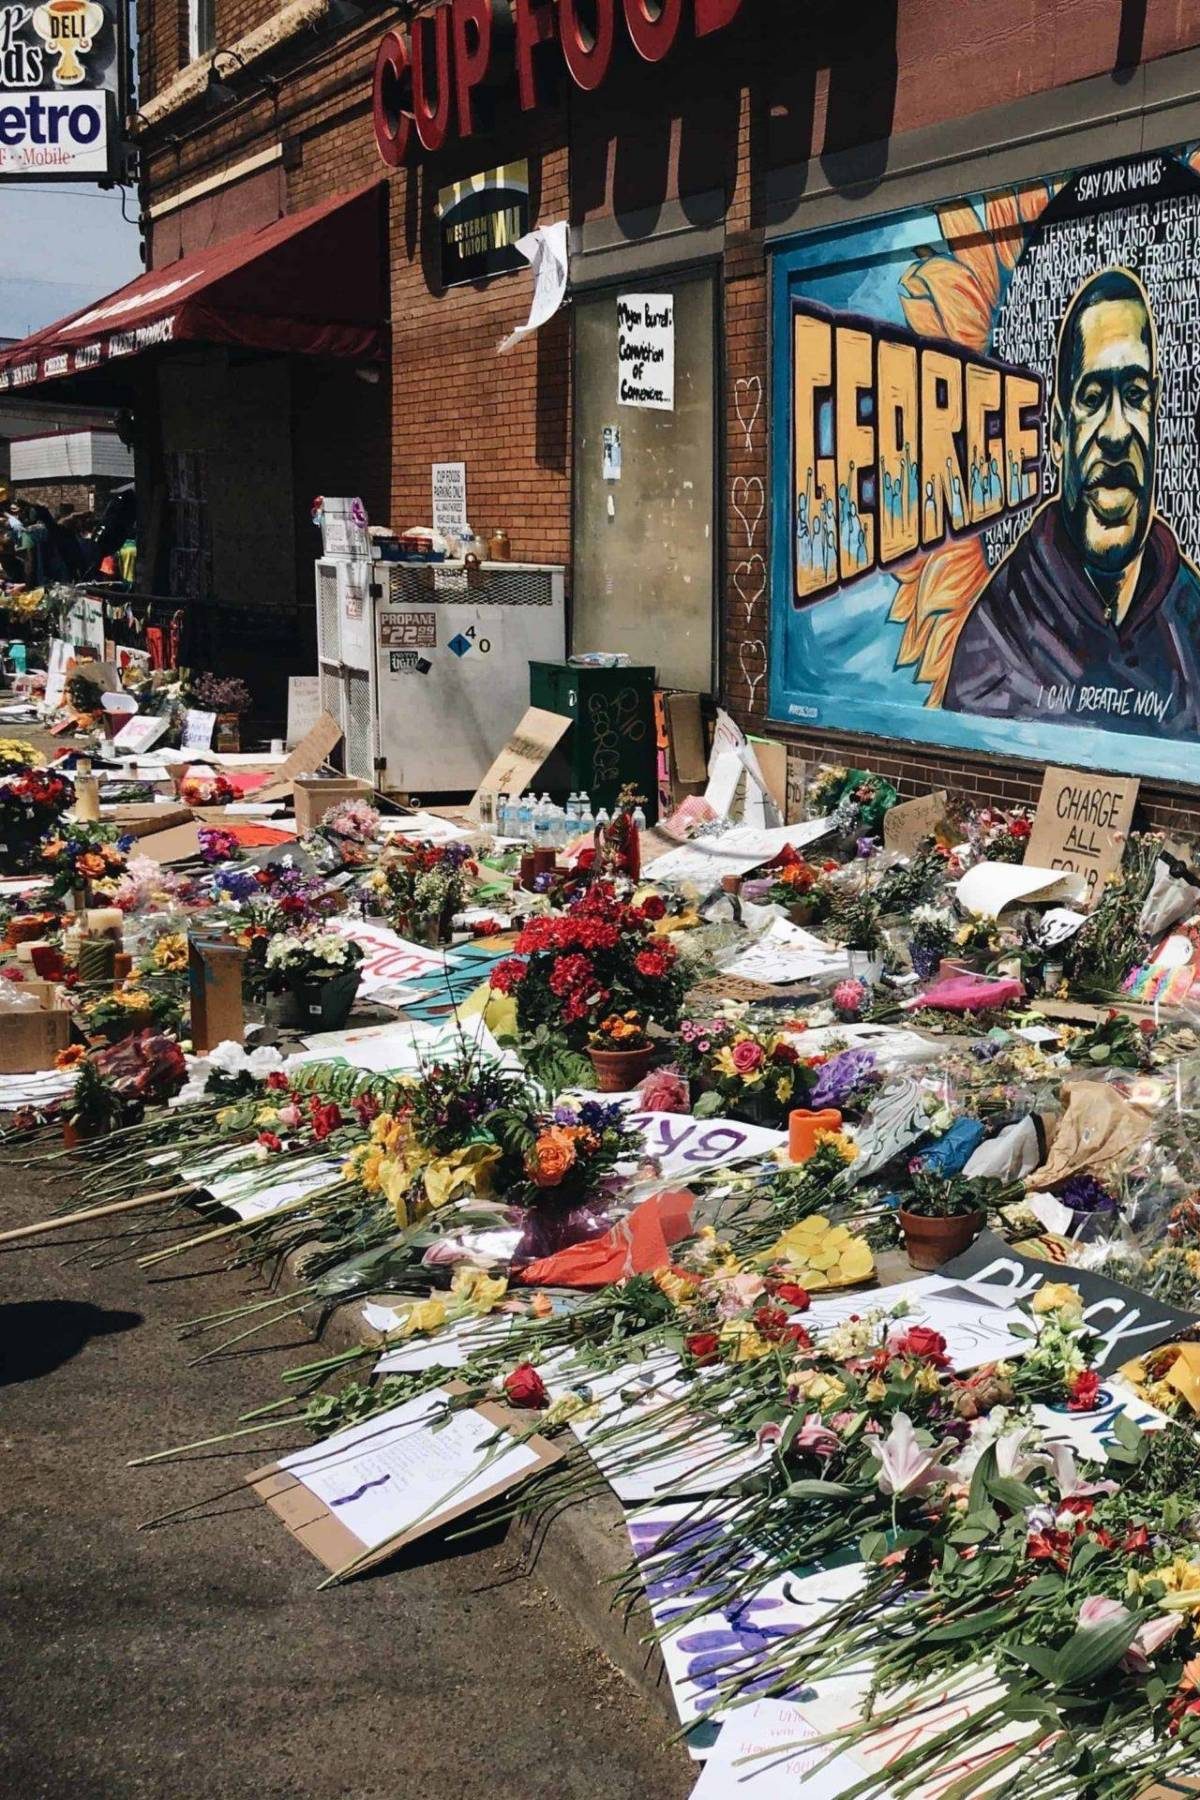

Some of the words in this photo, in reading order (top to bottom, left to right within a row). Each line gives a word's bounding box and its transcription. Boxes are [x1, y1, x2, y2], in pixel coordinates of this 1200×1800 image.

[50, 15, 86, 39] DELI
[373, 0, 491, 167] CUP
[0, 95, 101, 145] etro
[23, 148, 71, 165] Mobile
[1077, 173, 1101, 202] SAY
[1103, 166, 1127, 196] OUR
[1128, 158, 1162, 190] NAMES
[446, 216, 488, 244] WESTERN
[1042, 214, 1095, 245] TERRENCE
[1096, 226, 1156, 253] PHILANDO
[459, 234, 488, 259] UNION
[1104, 246, 1138, 268] JAMES
[1145, 239, 1192, 266] FREDDIE
[1006, 281, 1047, 306] MICHAEL
[1014, 321, 1056, 343] GARNER
[999, 342, 1037, 364] SANDRA
[1157, 345, 1189, 371] REKIA
[632, 361, 645, 381] of
[1158, 390, 1200, 418] SHELLY
[1158, 416, 1198, 444] TAMAR
[794, 312, 1041, 600] GEORGE
[1156, 468, 1200, 491] TARIKA
[1156, 490, 1194, 517] ALTON
[381, 613, 435, 625] PROPANE
[465, 625, 477, 640] 4
[479, 638, 491, 653] 0
[1036, 684, 1044, 708] I
[1047, 683, 1076, 711] CAN
[1076, 685, 1135, 716] BREATHE
[1134, 688, 1173, 724] NOW
[1056, 785, 1124, 830] CHARGE
[1065, 825, 1101, 852] ALL
